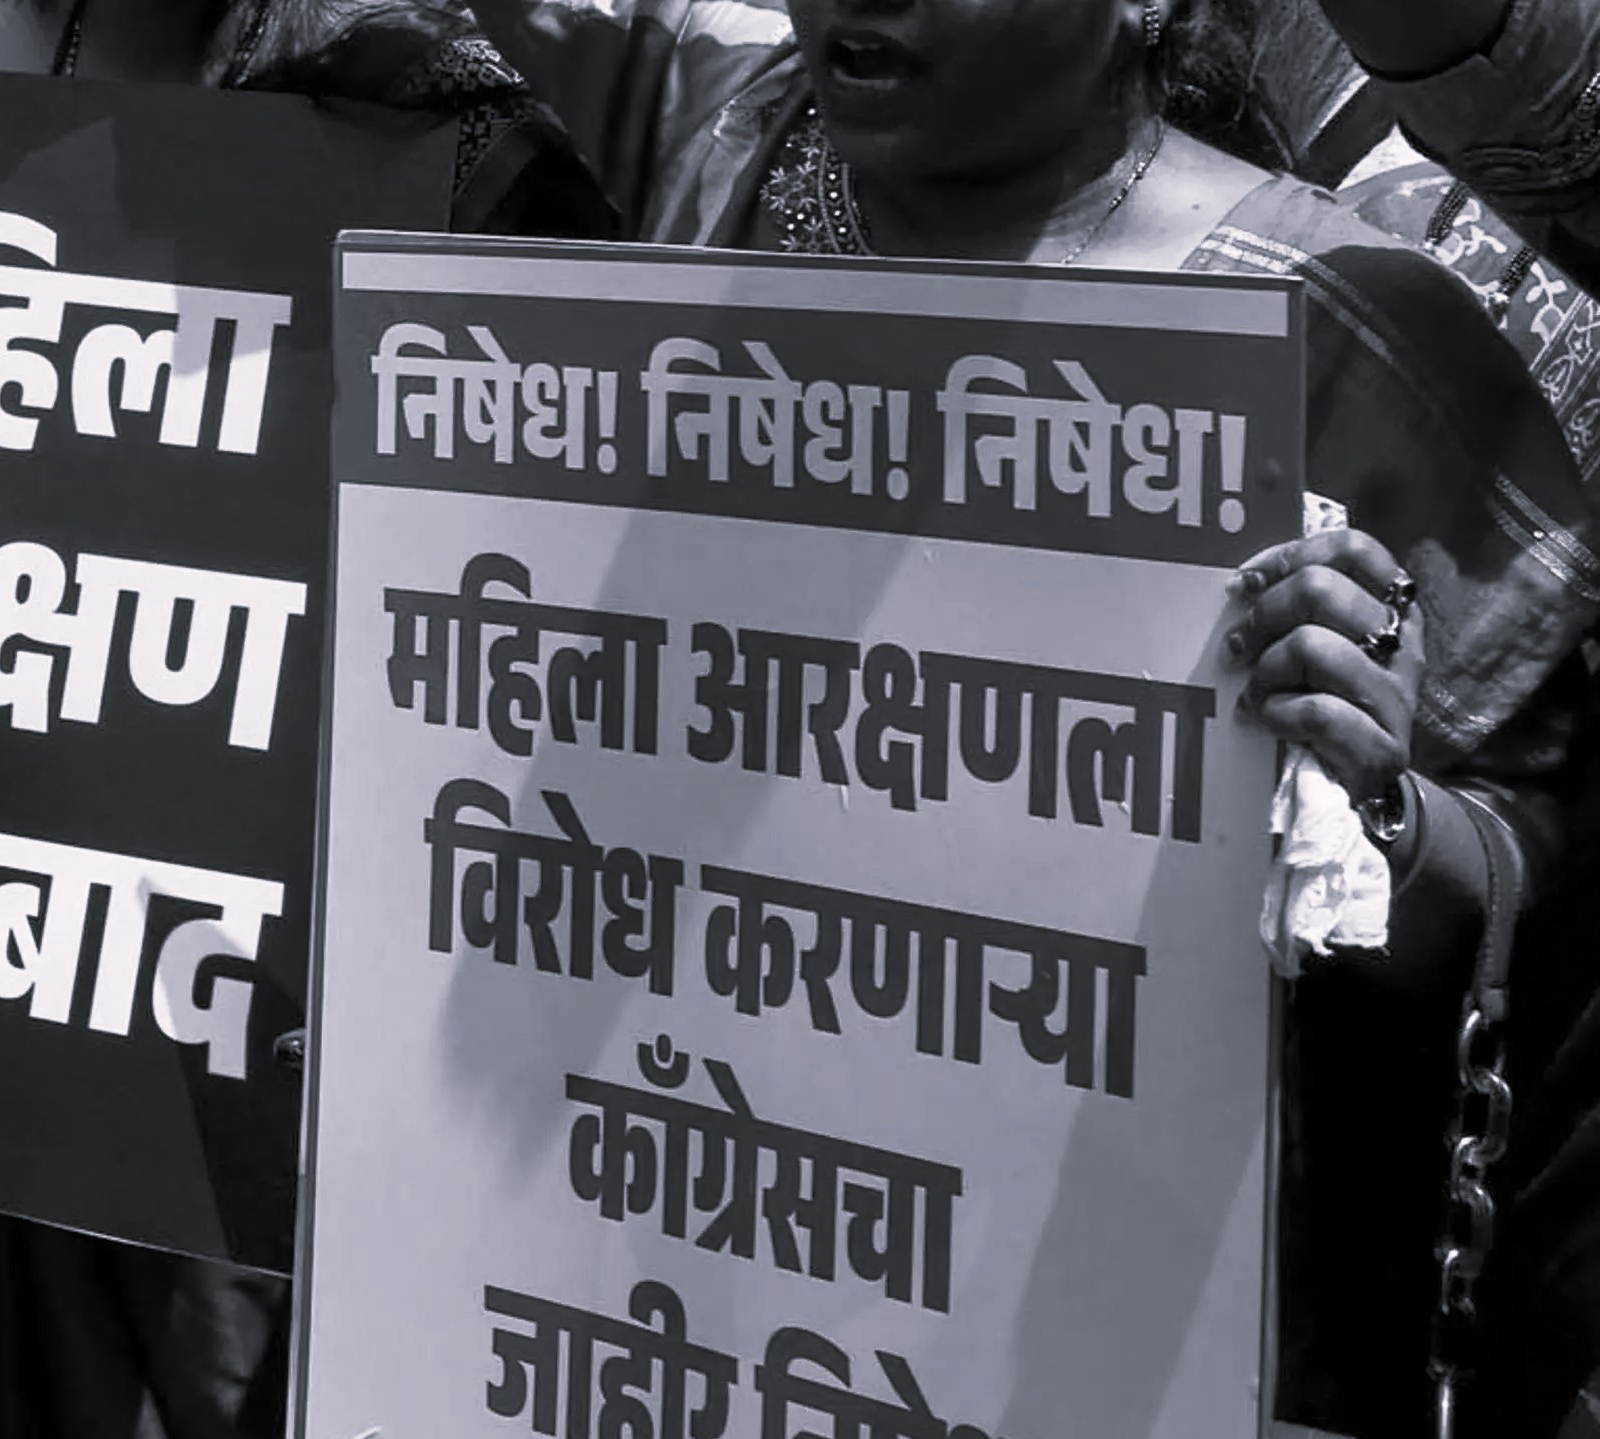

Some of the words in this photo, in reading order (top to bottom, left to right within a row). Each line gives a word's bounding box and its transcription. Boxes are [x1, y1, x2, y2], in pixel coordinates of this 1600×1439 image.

[371, 323, 620, 476] निषेध!
[640, 337, 910, 501] निषेध!
[936, 355, 1249, 535] निषेध!
[383, 552, 669, 758] महिला
[687, 621, 1217, 845] आरक्षणला
[423, 778, 684, 998] विरोध
[565, 1032, 964, 1316] काँग्रेसचा
[484, 1280, 739, 1439] जाहीर
